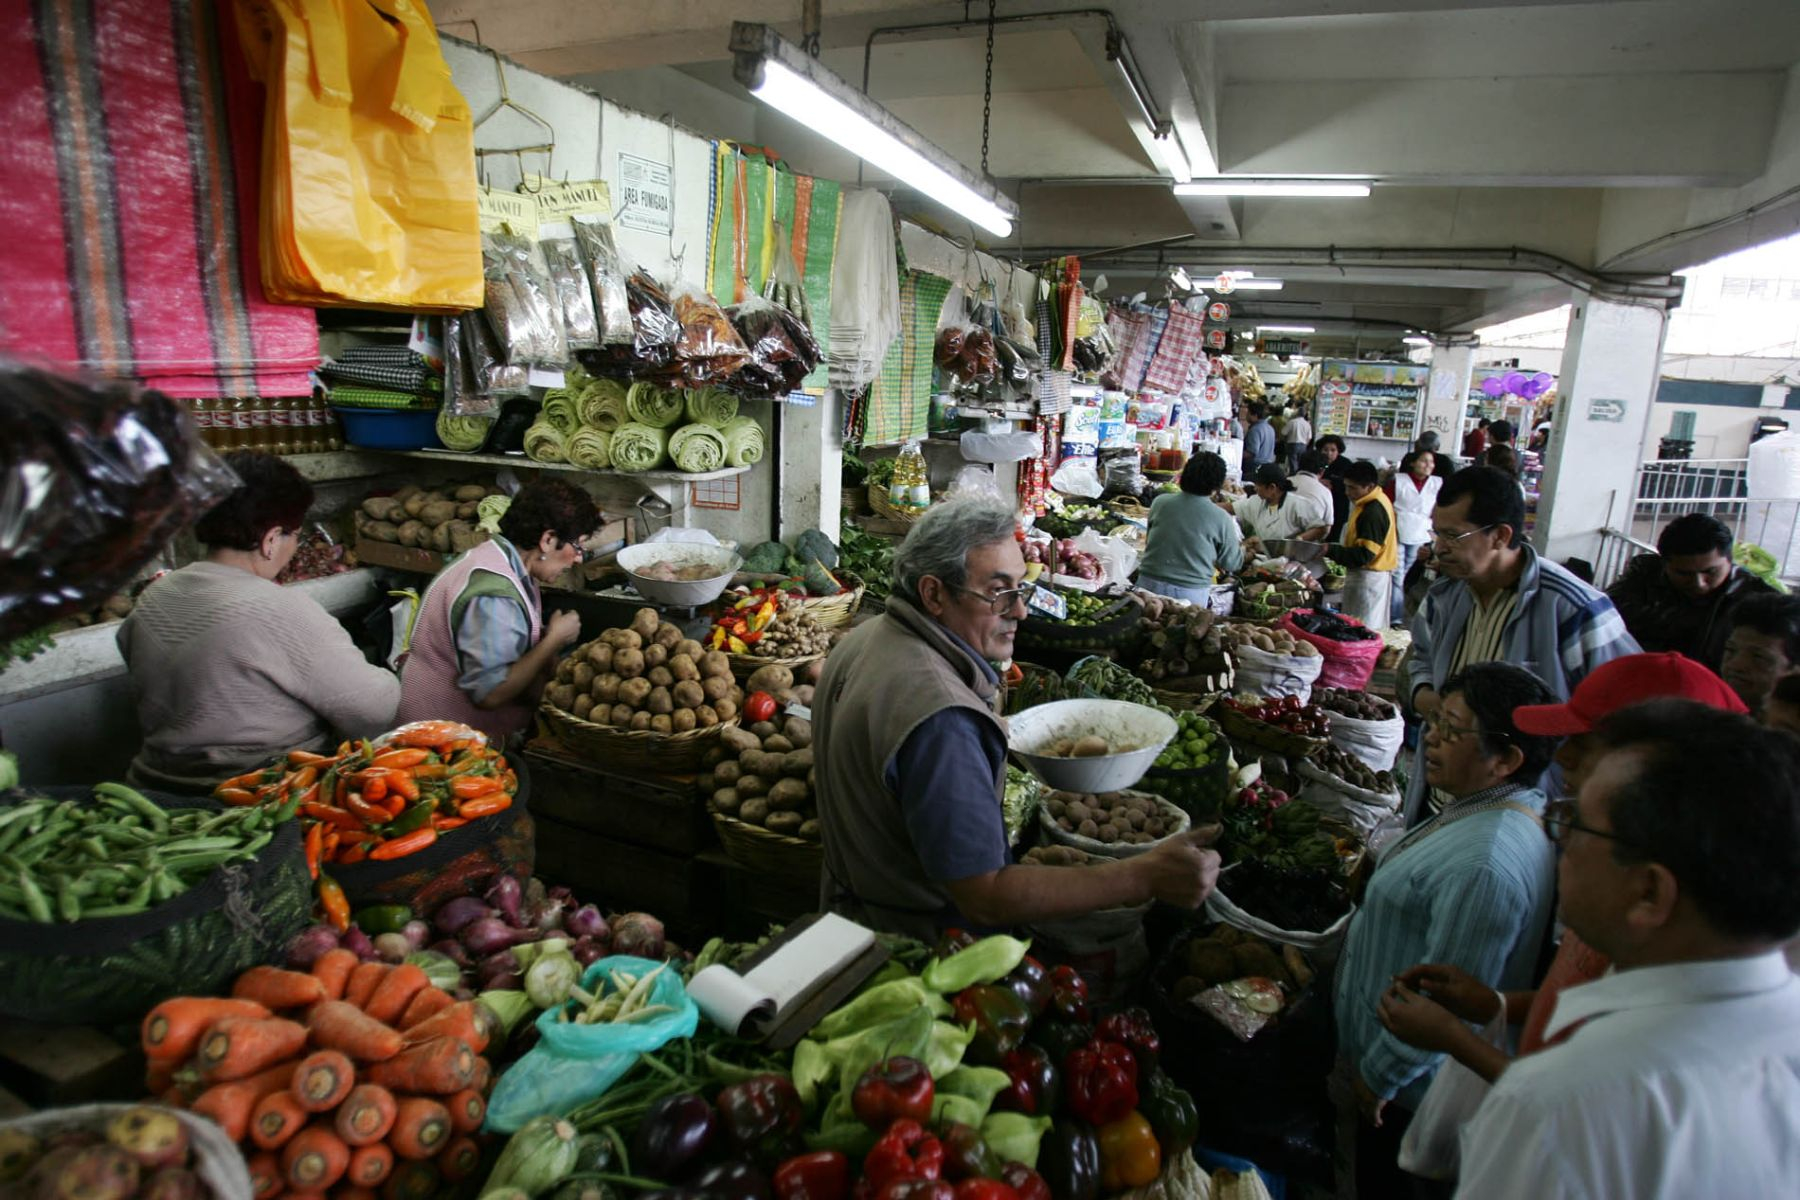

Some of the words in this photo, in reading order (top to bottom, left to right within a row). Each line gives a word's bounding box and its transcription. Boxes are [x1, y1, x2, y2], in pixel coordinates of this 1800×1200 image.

[562, 187, 599, 205] MANUEL
[624, 186, 639, 205] AREA
[641, 190, 669, 212] FUMIGADA
[488, 200, 522, 217] MANUEL
